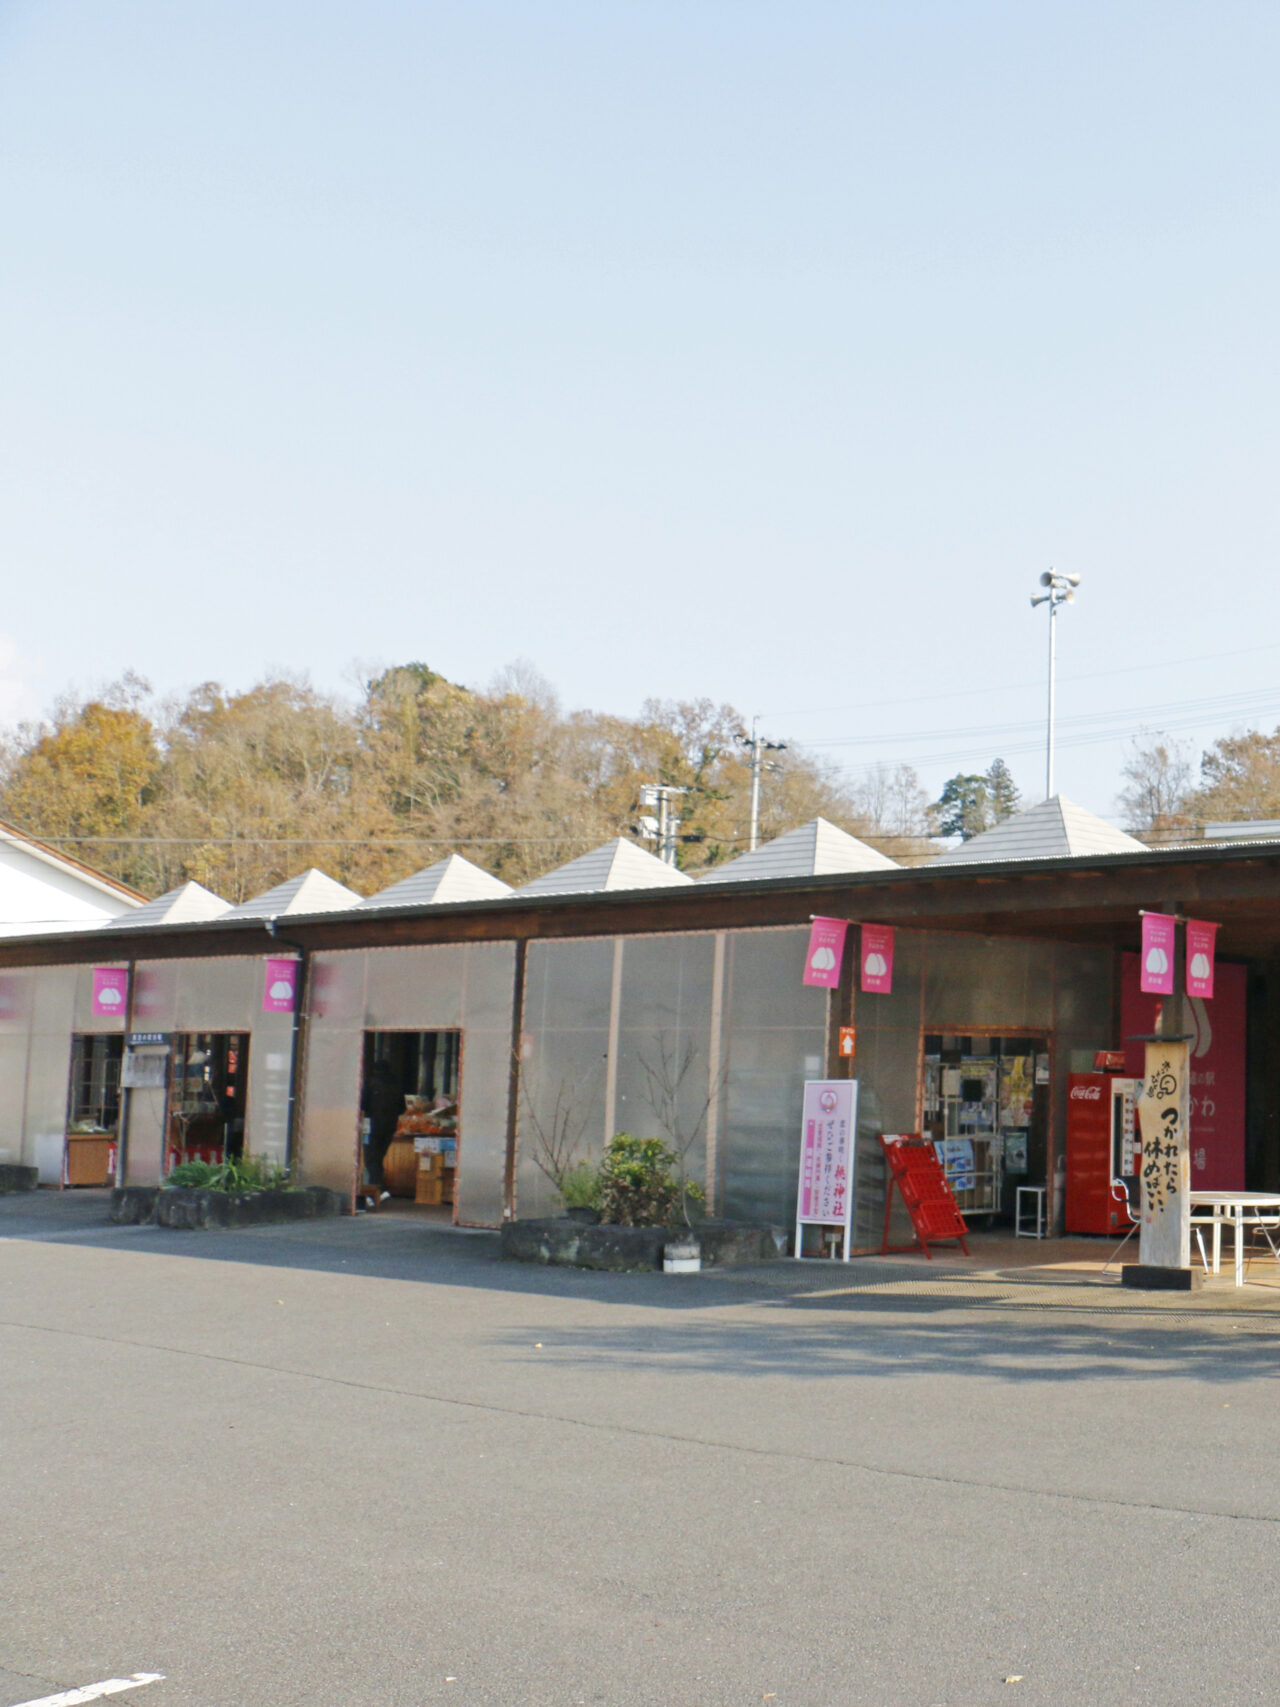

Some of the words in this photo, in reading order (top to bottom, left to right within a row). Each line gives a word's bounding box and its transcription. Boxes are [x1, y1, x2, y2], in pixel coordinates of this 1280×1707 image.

[1070, 1085, 1102, 1100] Coca-Cola
[1143, 1136, 1165, 1213] 休めばいい
[1160, 1107, 1179, 1195] つかれたら
